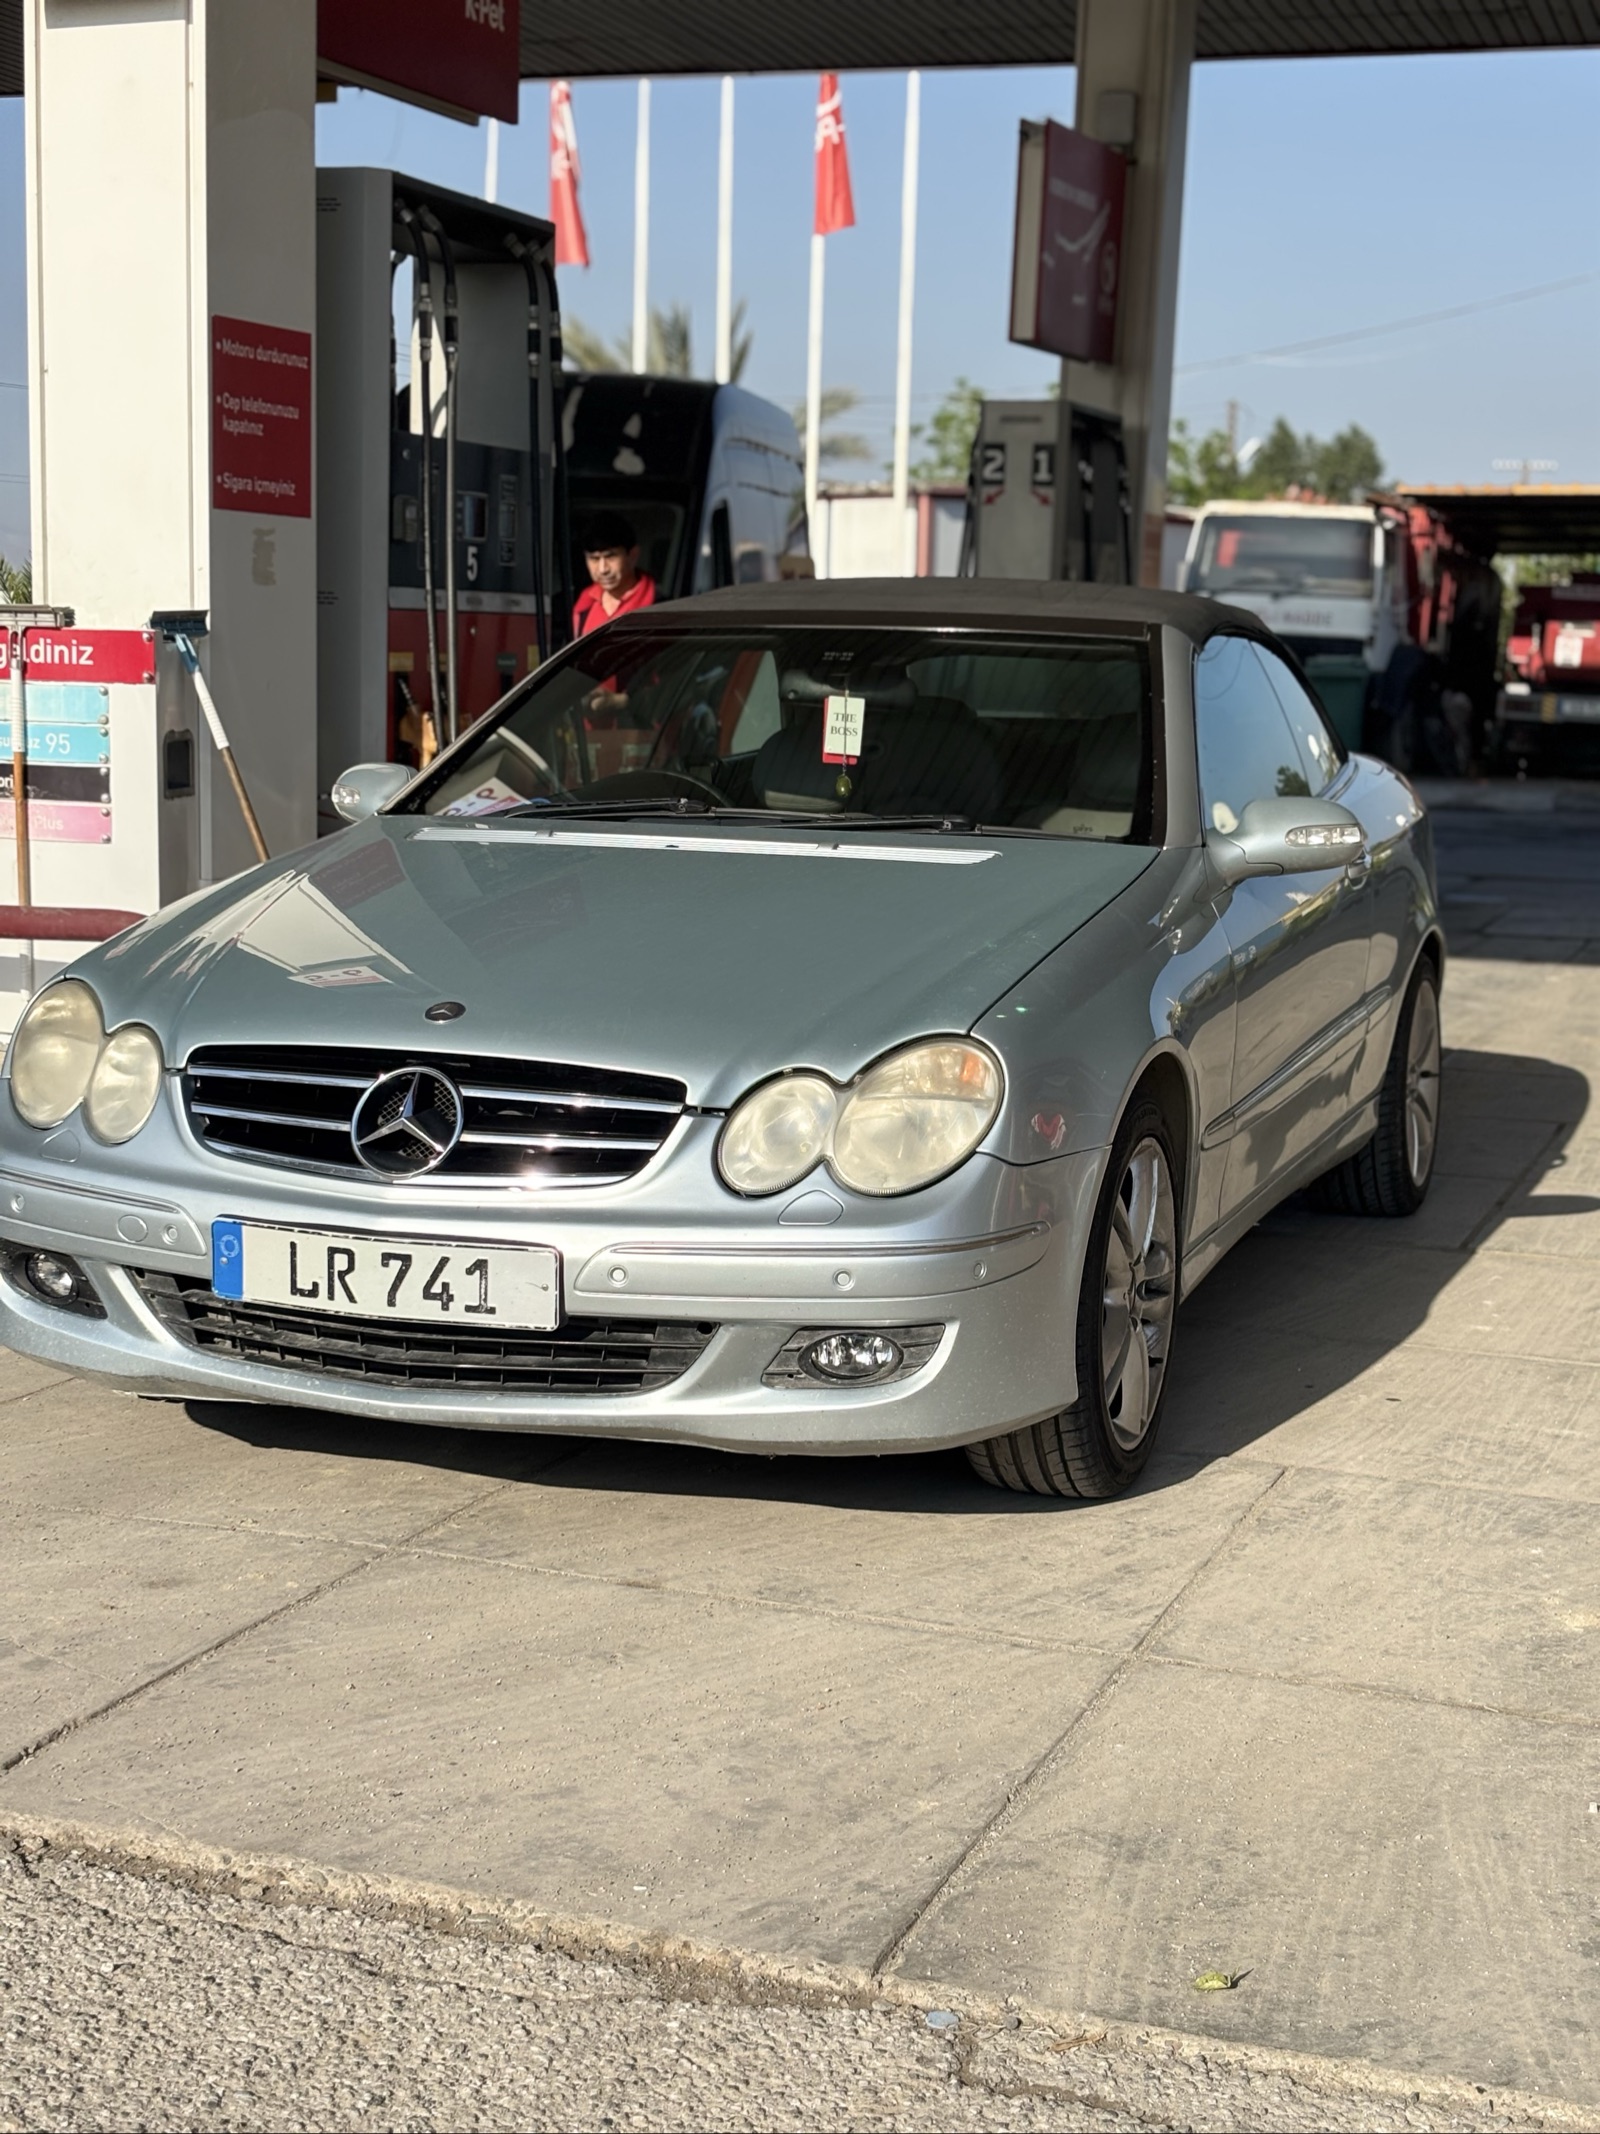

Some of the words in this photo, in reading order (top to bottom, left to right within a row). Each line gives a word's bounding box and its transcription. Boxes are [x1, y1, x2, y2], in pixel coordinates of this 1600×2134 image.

[222, 338, 254, 359] Motoru
[256, 345, 308, 369] durdurunuz
[223, 392, 240, 414] Cep
[241, 396, 299, 419] telefonunuzu
[983, 448, 1004, 480] 2
[1034, 449, 1054, 482] 1
[223, 472, 253, 493] Sigara
[254, 476, 296, 498] içmeyiniz
[467, 546, 479, 581] 5
[830, 725, 858, 736] BOSS
[833, 712, 857, 723] THE
[45, 732, 71, 755] 95
[34, 815, 64, 831] Plus
[290, 1241, 358, 1304] LR
[381, 1252, 496, 1315] 741
